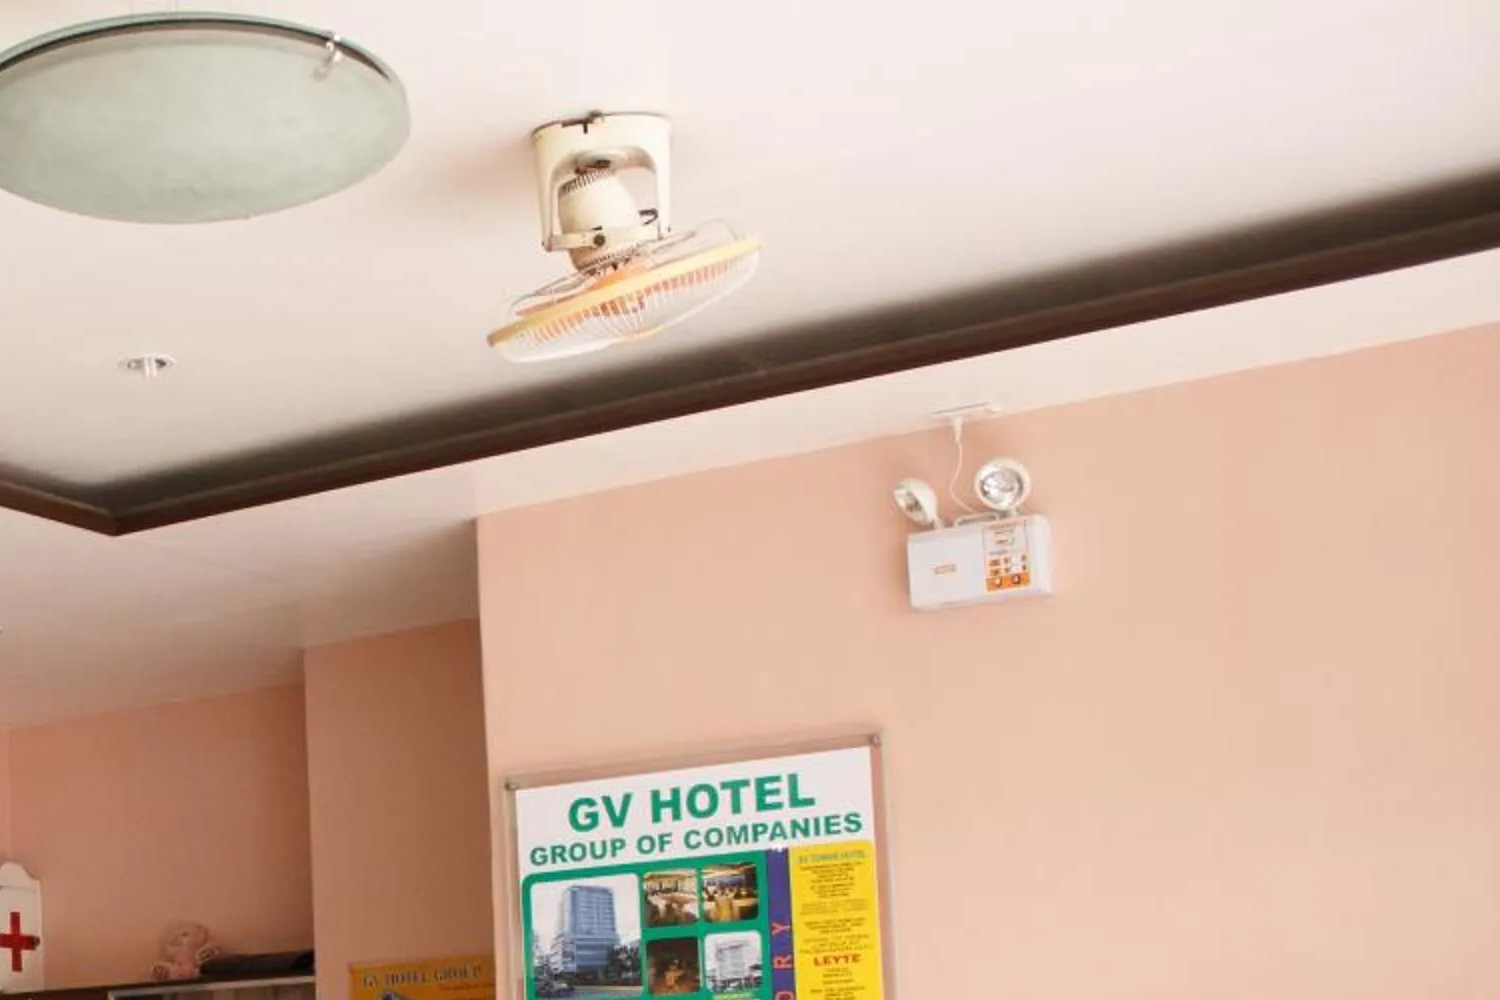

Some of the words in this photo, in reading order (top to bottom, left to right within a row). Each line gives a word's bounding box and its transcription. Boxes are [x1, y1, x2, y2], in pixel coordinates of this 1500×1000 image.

[568, 792, 634, 833] GV
[651, 773, 816, 824] HOTEL
[529, 838, 626, 867] GROUP
[637, 831, 673, 854] OF
[683, 812, 863, 850] COMPANIES
[813, 954, 861, 966] LEYTE
